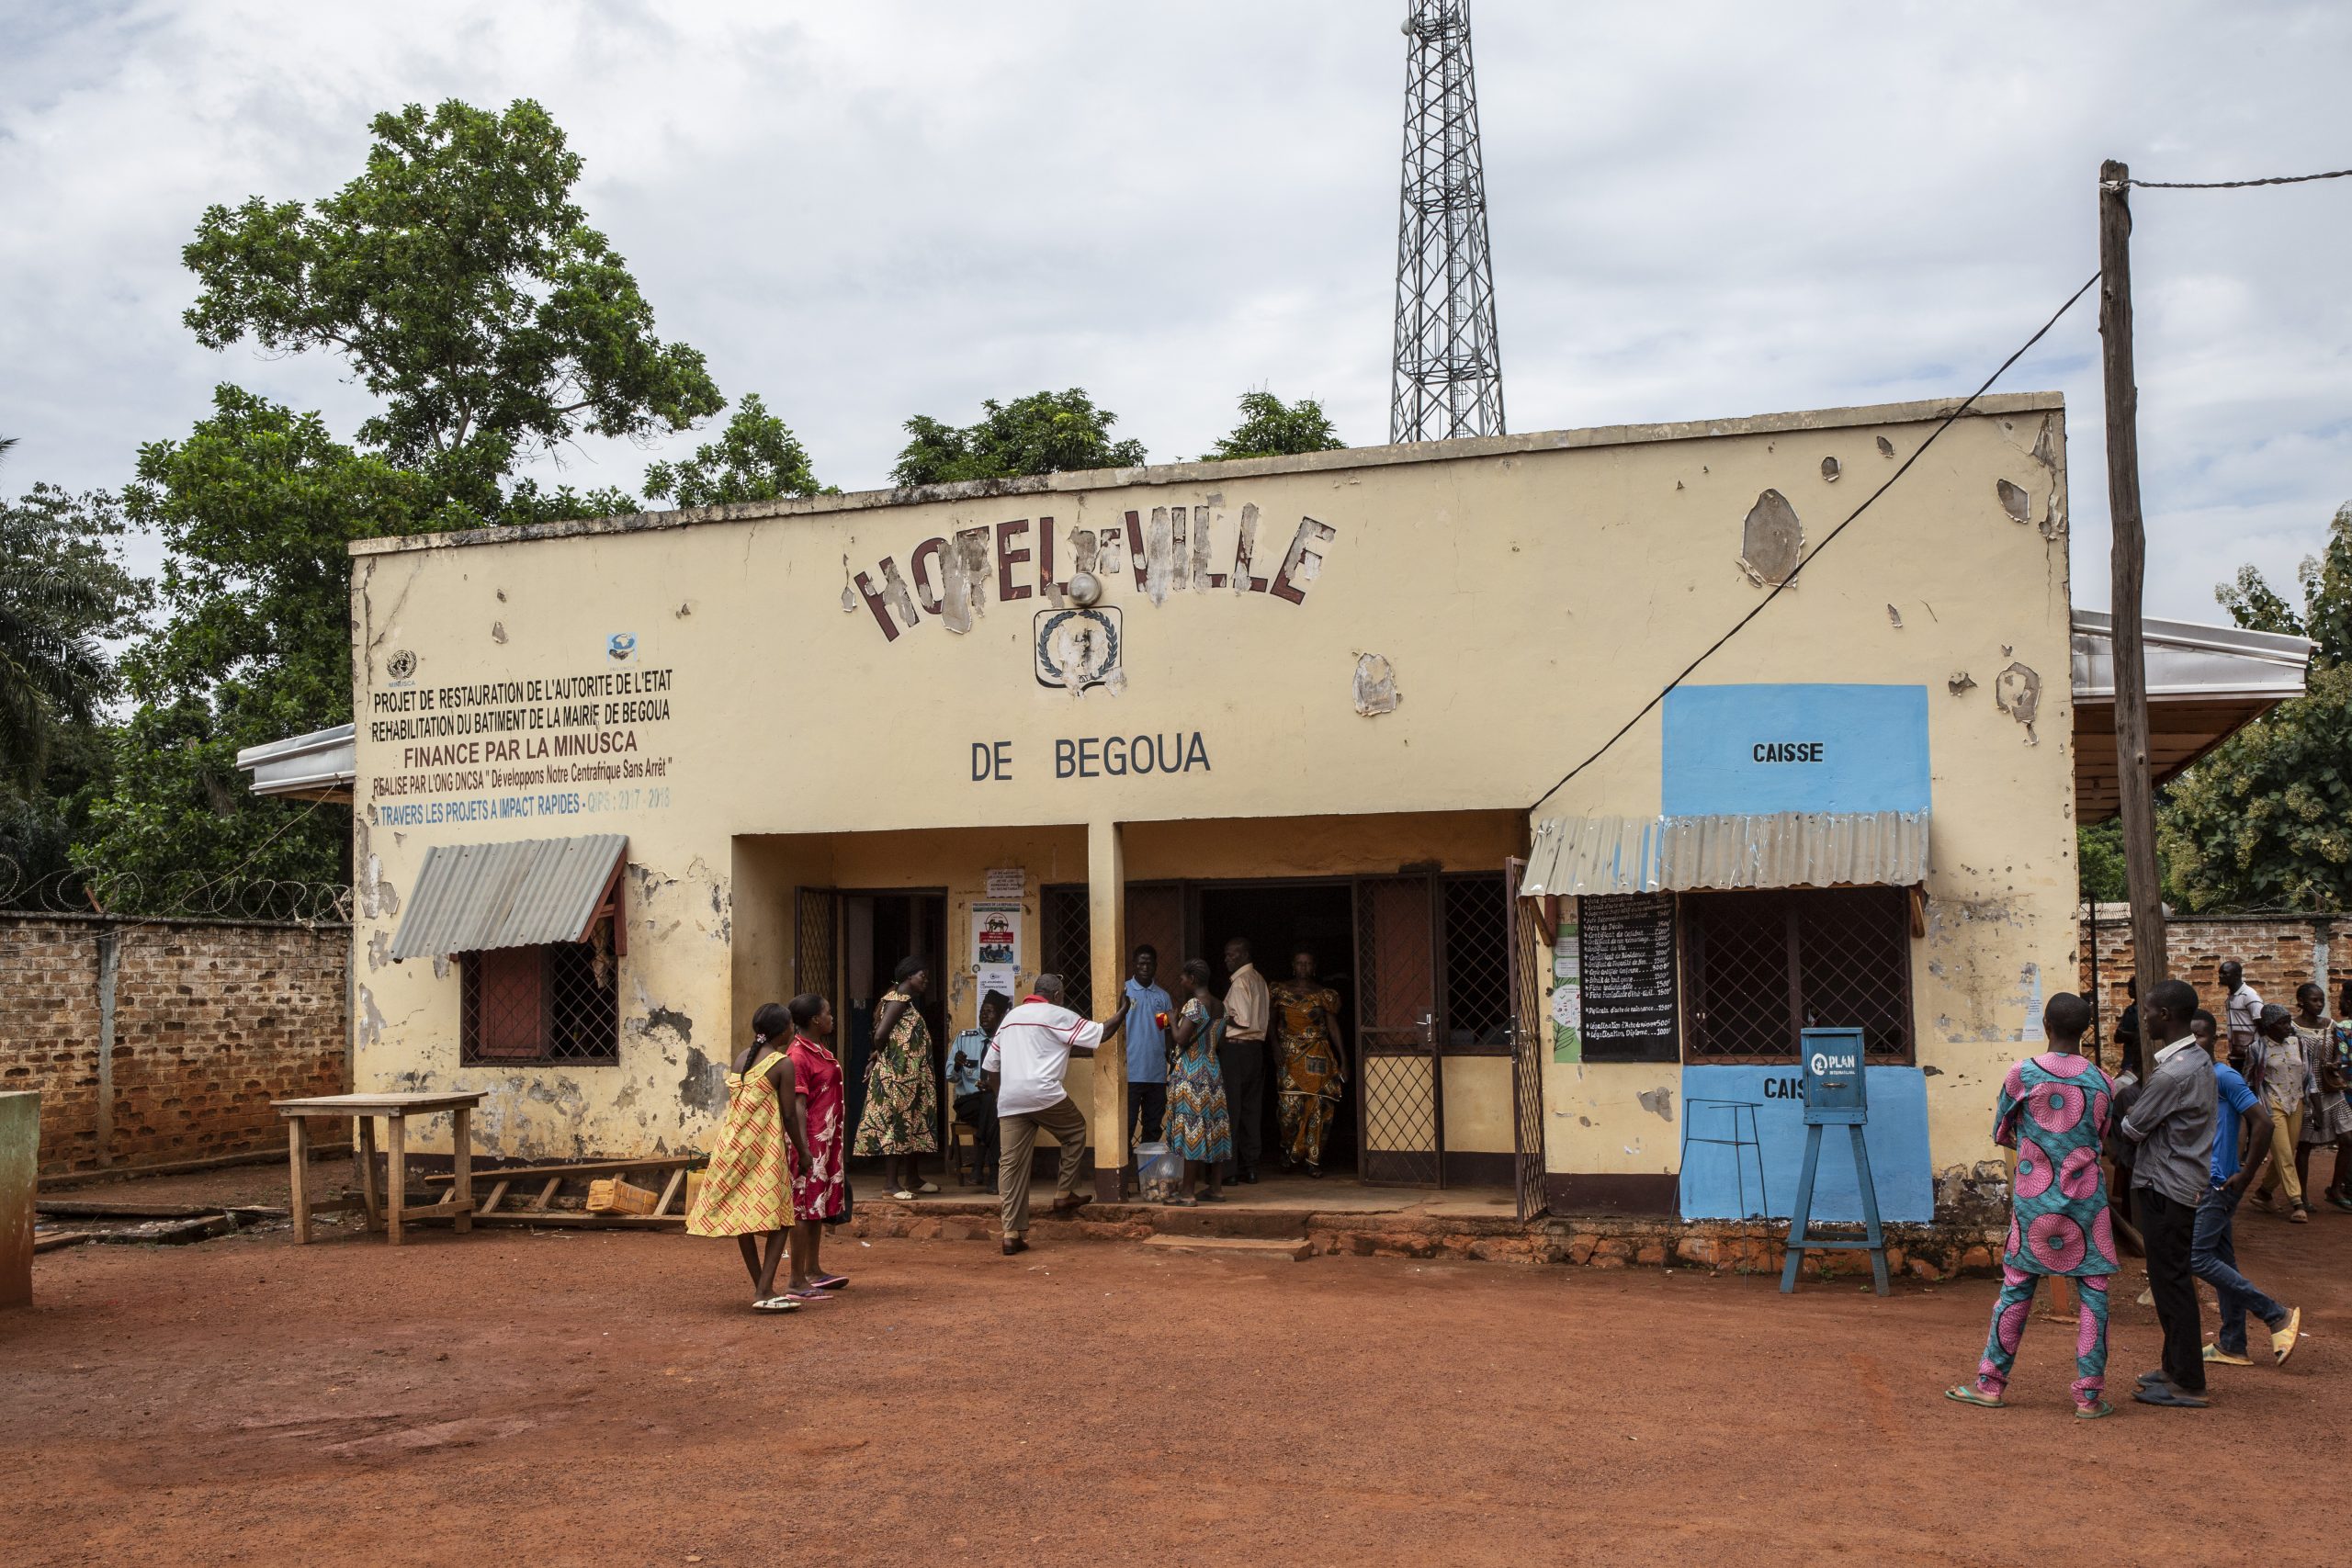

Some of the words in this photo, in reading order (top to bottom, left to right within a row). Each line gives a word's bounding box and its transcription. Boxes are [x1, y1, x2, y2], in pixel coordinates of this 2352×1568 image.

[1125, 506, 1336, 606] VILLE
[374, 690, 417, 714] PROJET
[419, 689, 435, 711] DE
[439, 681, 524, 709] RESTAURATION
[526, 680, 543, 702] DE
[546, 674, 613, 701] L'AUTORITE
[616, 672, 632, 694] DE
[635, 669, 673, 694] L'ETAT
[388, 680, 416, 688] MINUSCA
[371, 715, 454, 742] REHABILITATION
[457, 713, 471, 736] DU
[474, 708, 526, 734] BATIMENT
[529, 707, 544, 730] DE
[547, 706, 560, 728] LA
[563, 704, 600, 728] MAIRIE
[605, 702, 619, 725] DE
[622, 698, 671, 724] BEGOUA
[404, 742, 480, 769] FINANCE
[485, 739, 521, 762] PAR
[526, 737, 549, 760] LA
[554, 730, 638, 758] MINUSCA
[971, 739, 1012, 782] DE
[1056, 731, 1211, 779] BEGOUA
[1753, 742, 1824, 762] CAISSE
[373, 776, 408, 797] REALISE
[410, 774, 426, 795] PAR
[428, 772, 453, 794] L'ONG
[455, 770, 484, 791] DNCSA
[492, 768, 544, 790] Développons
[546, 763, 569, 784] Notre
[571, 761, 621, 784] Centrafrique
[623, 758, 643, 779] Sans
[645, 756, 666, 777] Arrêt
[380, 804, 424, 826] TRAVERS
[425, 802, 443, 824] LES
[446, 799, 489, 823] PROJETS
[491, 799, 498, 819] A
[499, 795, 535, 819] IMPACT
[537, 793, 580, 816] RAPIDES
[1829, 1055, 1855, 1068] PLAN
[1764, 1077, 1804, 1100] CAI
